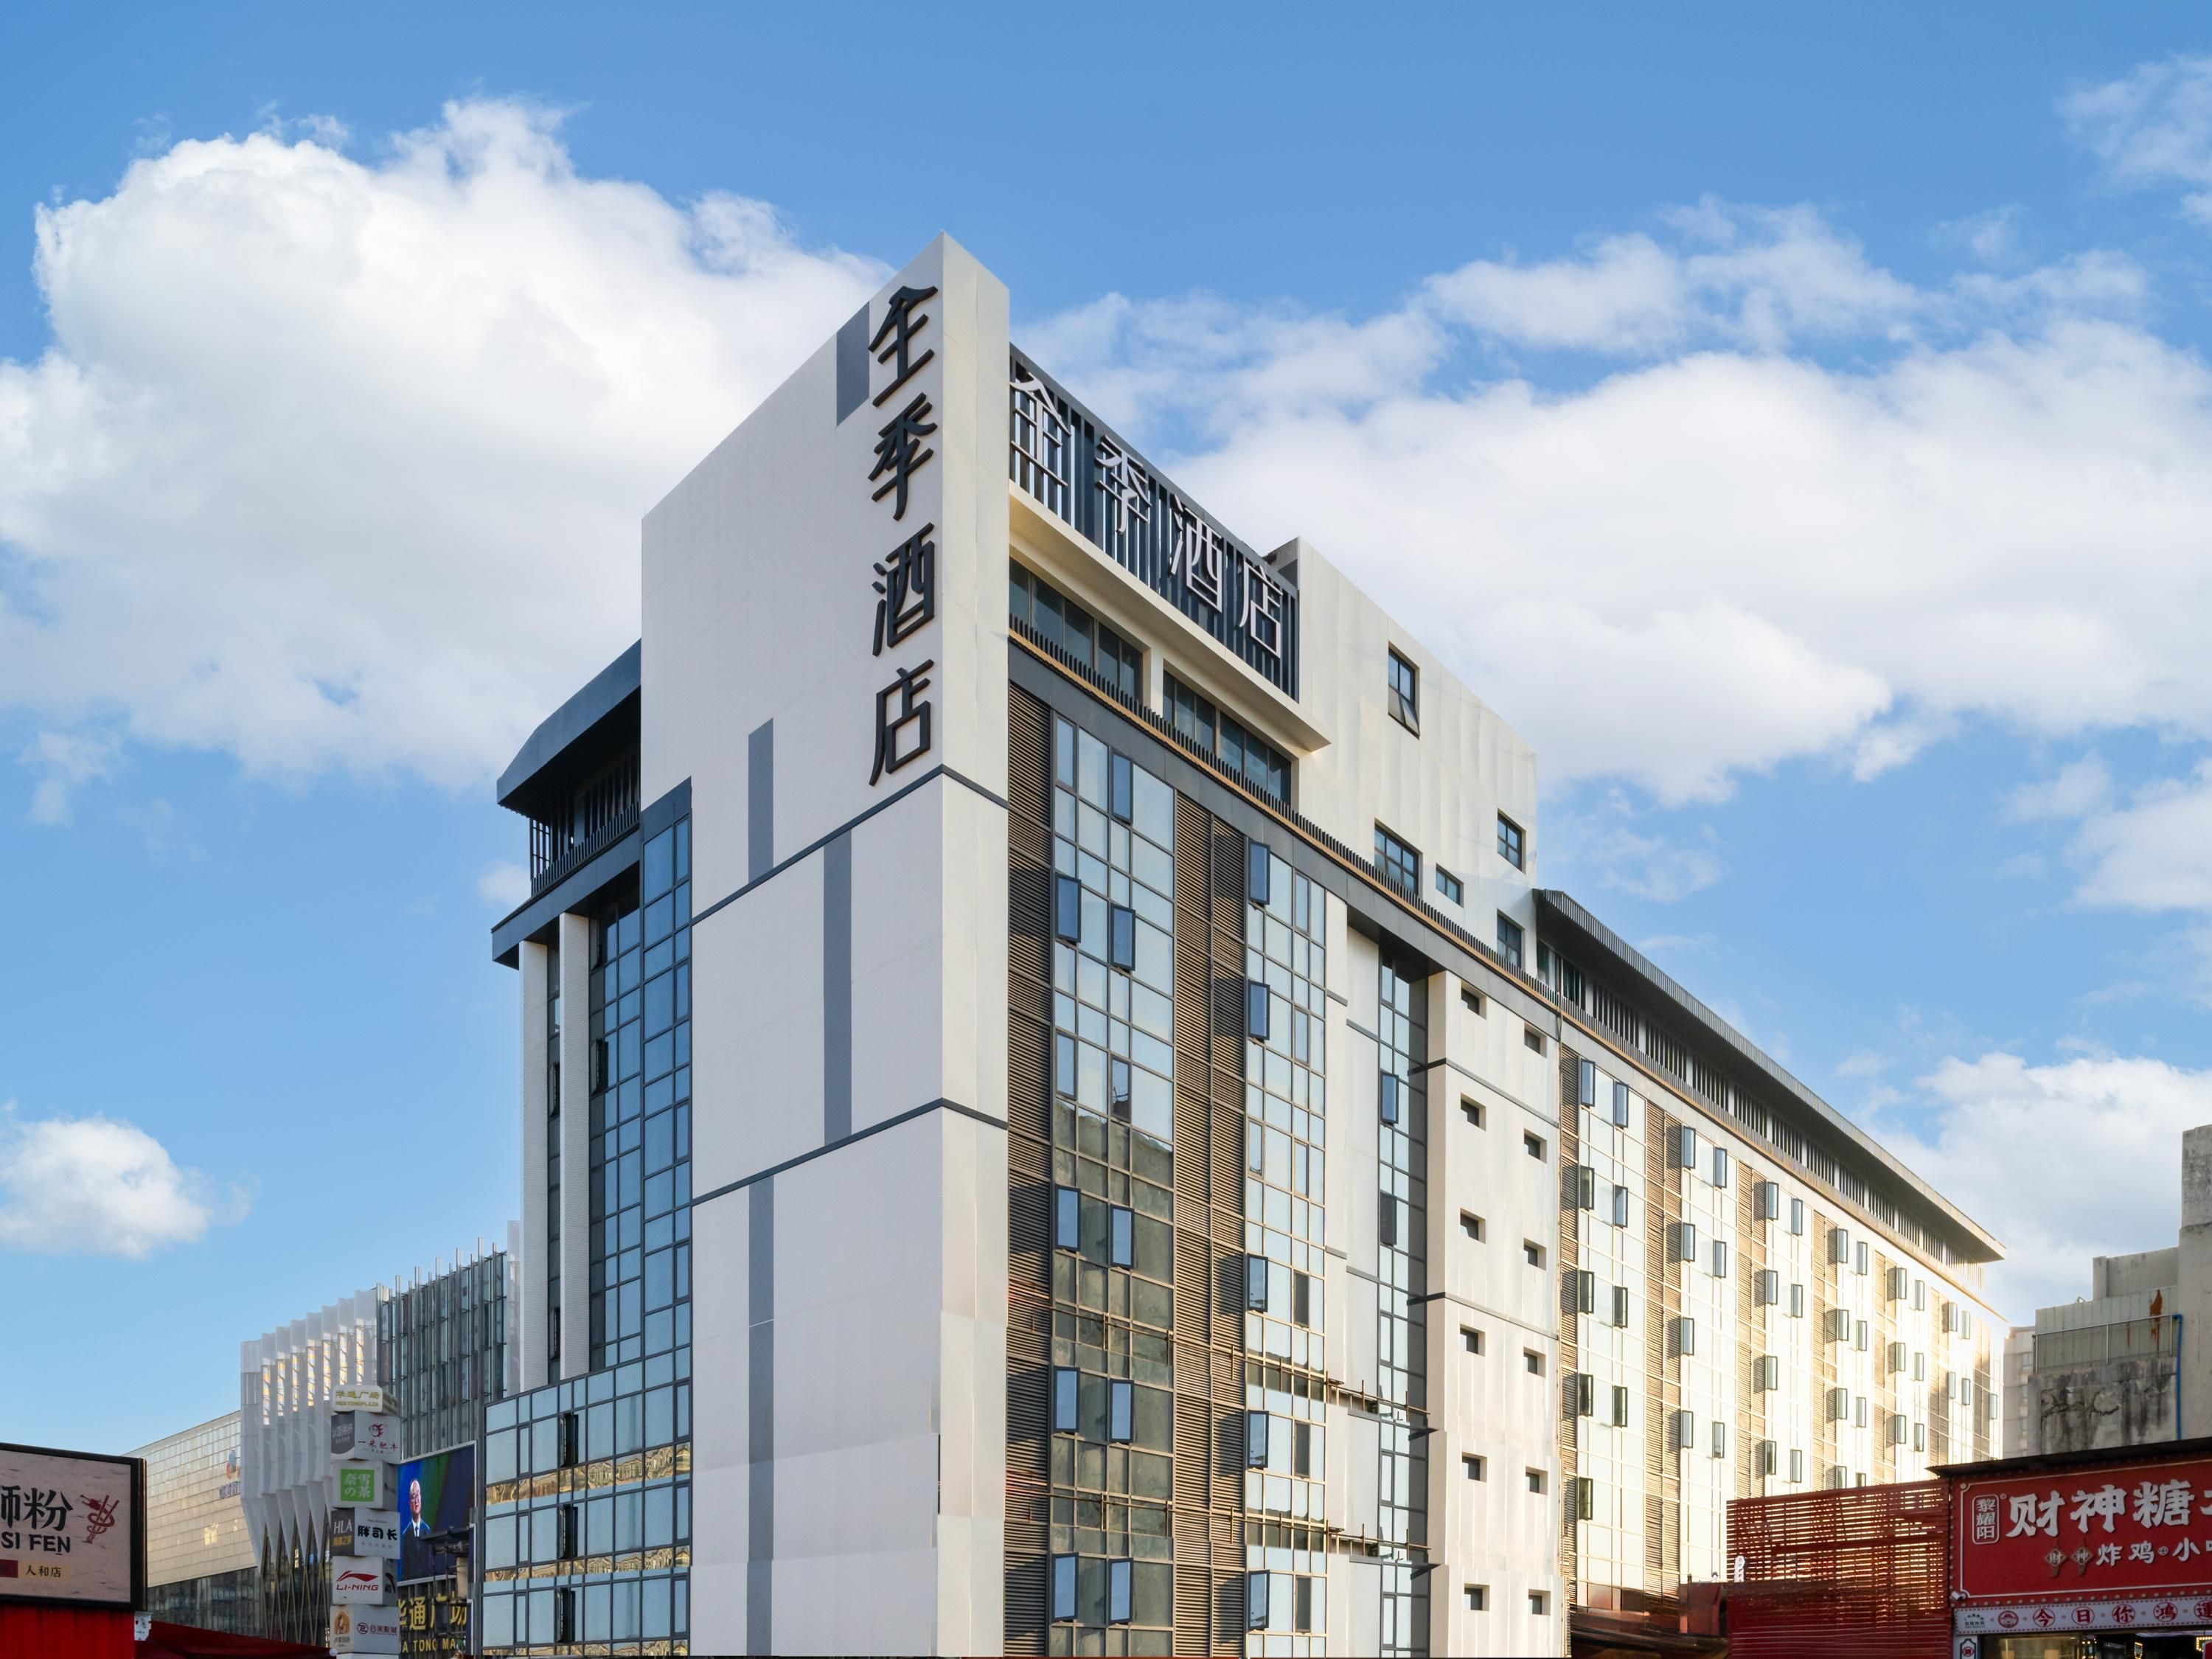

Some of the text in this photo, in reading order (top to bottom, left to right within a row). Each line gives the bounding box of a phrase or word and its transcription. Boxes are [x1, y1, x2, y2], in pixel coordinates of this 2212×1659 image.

[1010, 372, 1283, 658] 全季酒店
[868, 285, 938, 786] 全季酒店
[1976, 1498, 1995, 1540] 黎耀阳
[2006, 1479, 2212, 1537] 财神糖
[29, 1534, 71, 1553] FEN
[334, 1519, 352, 1534] HLA
[2096, 1540, 2154, 1566] 炸鸡
[26, 1565, 61, 1577] 人和店
